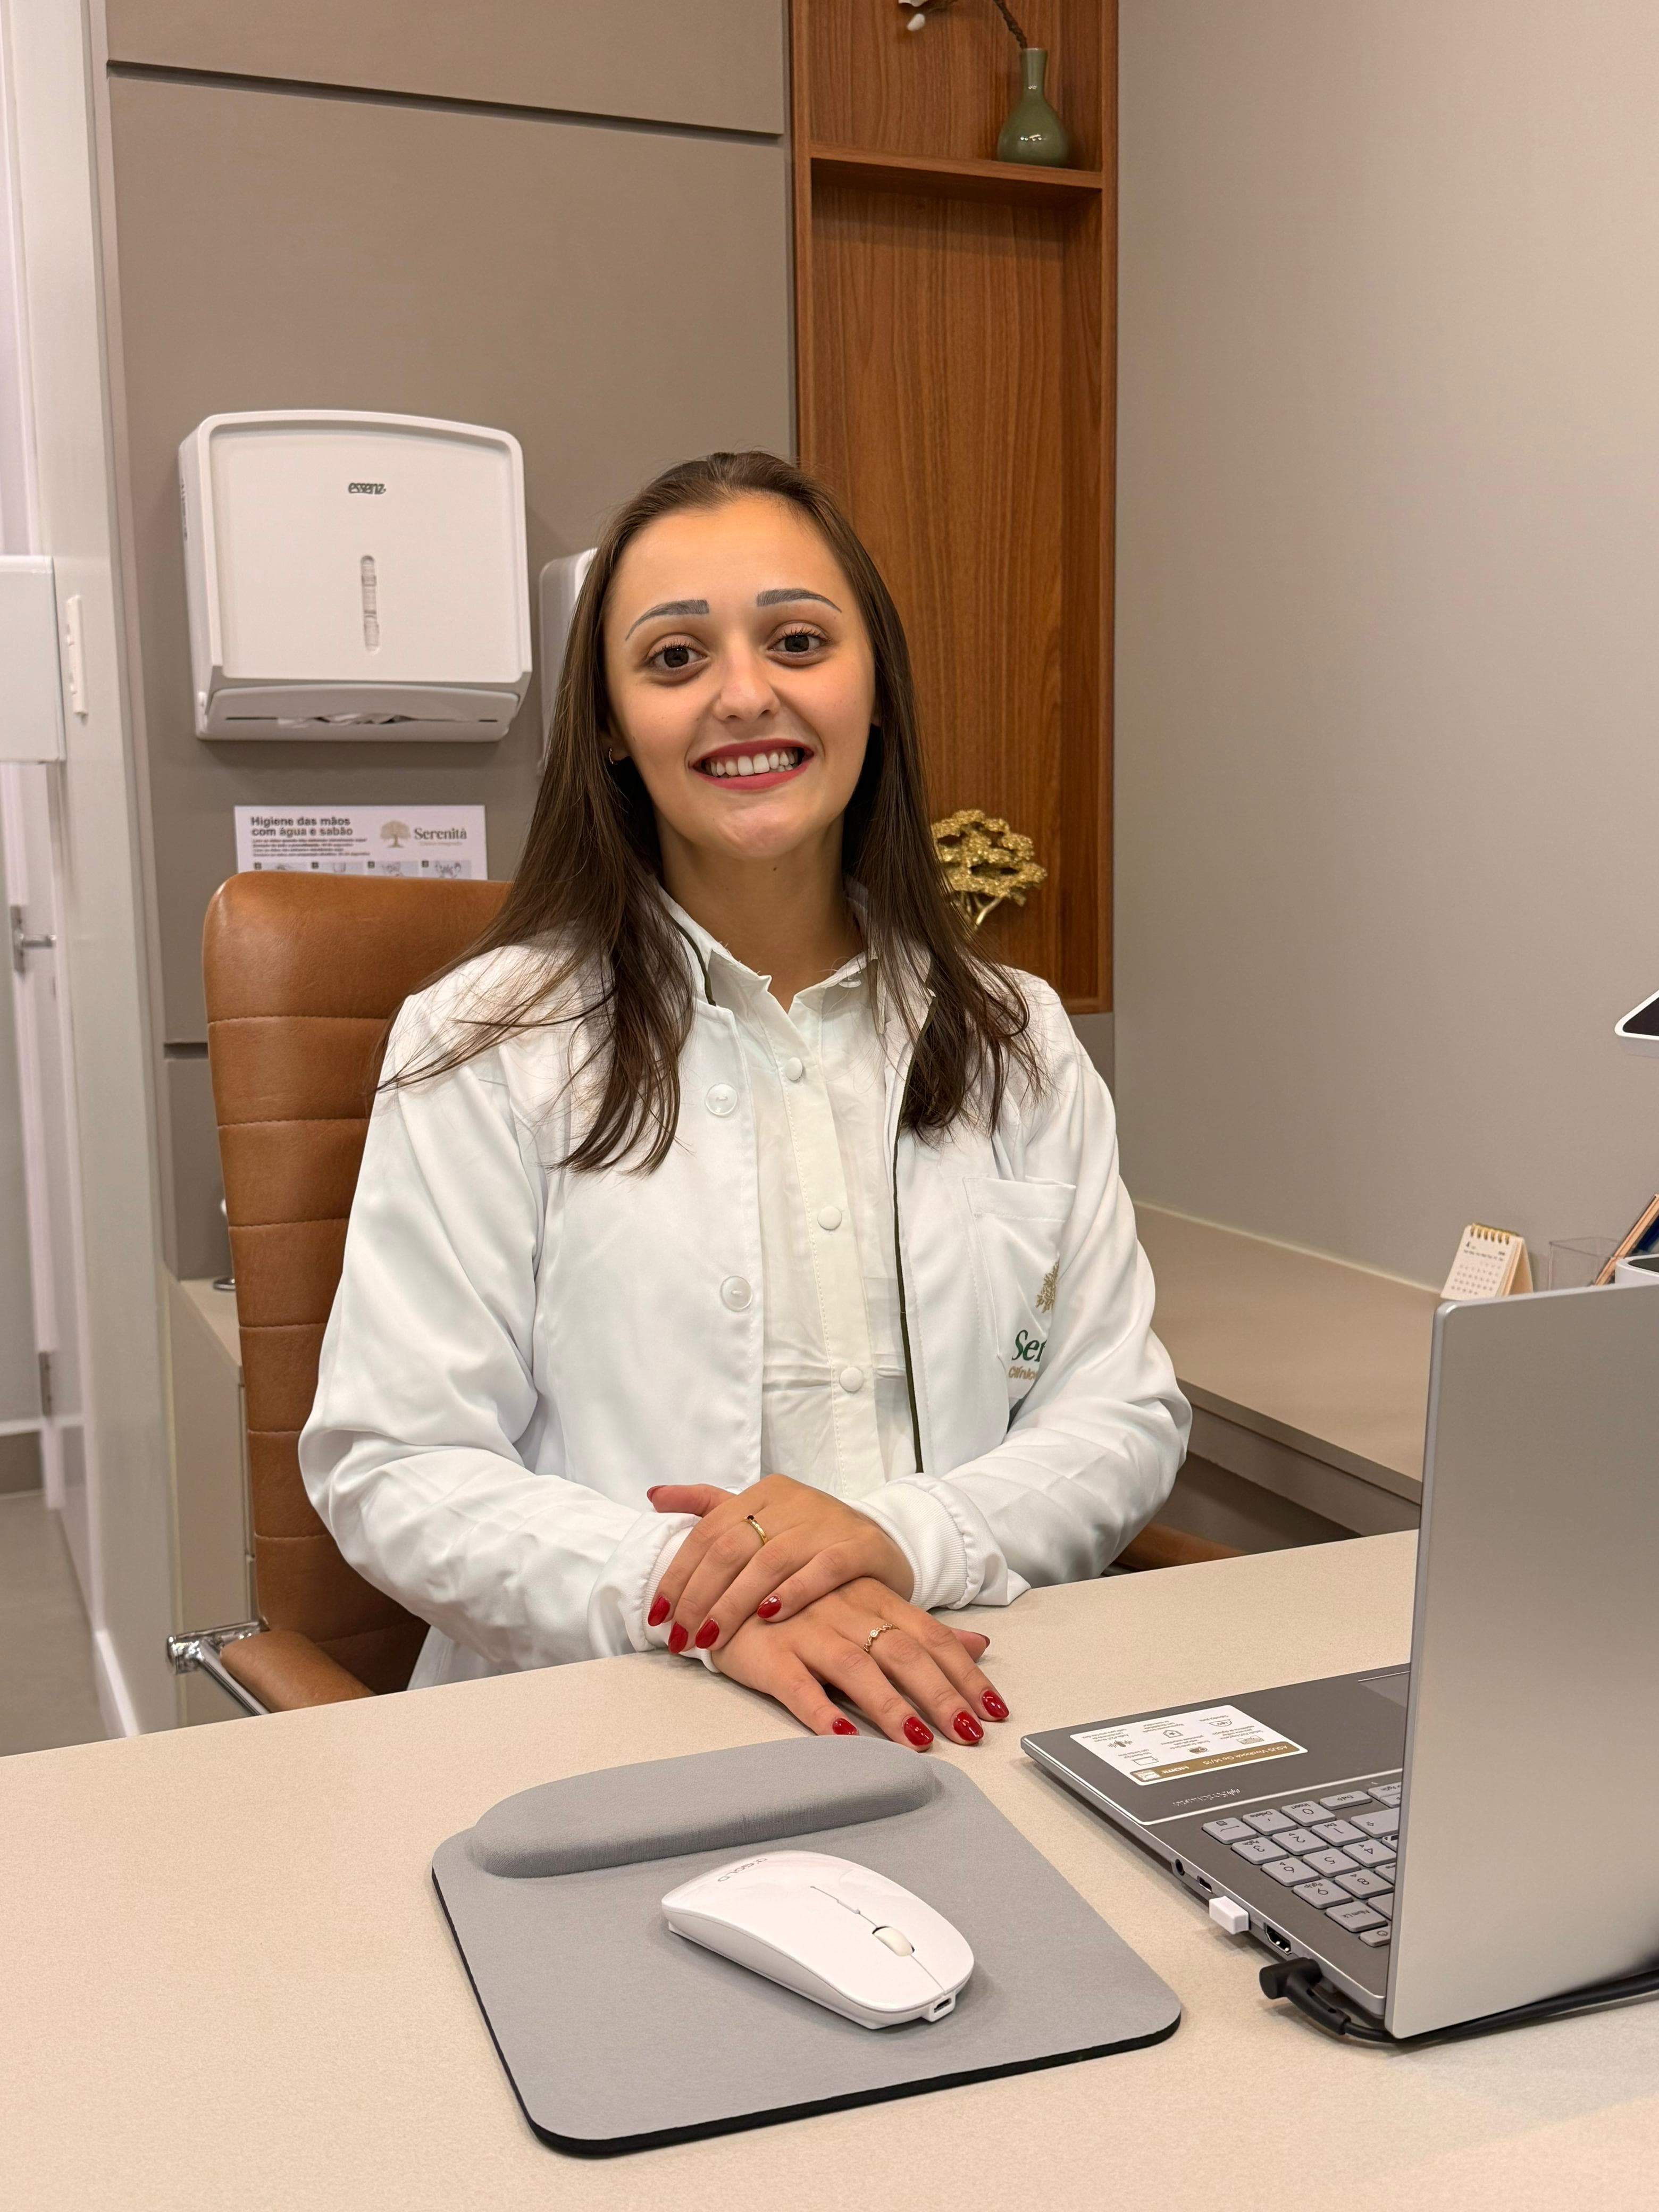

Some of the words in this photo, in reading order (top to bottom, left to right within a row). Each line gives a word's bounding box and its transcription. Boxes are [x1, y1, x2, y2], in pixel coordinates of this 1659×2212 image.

[251, 816, 294, 828] Higiene
[297, 816, 317, 826] das
[320, 816, 351, 826] mãos
[279, 827, 307, 838] água
[320, 827, 354, 836] sabão
[1008, 1365, 1036, 1380] Clínic
